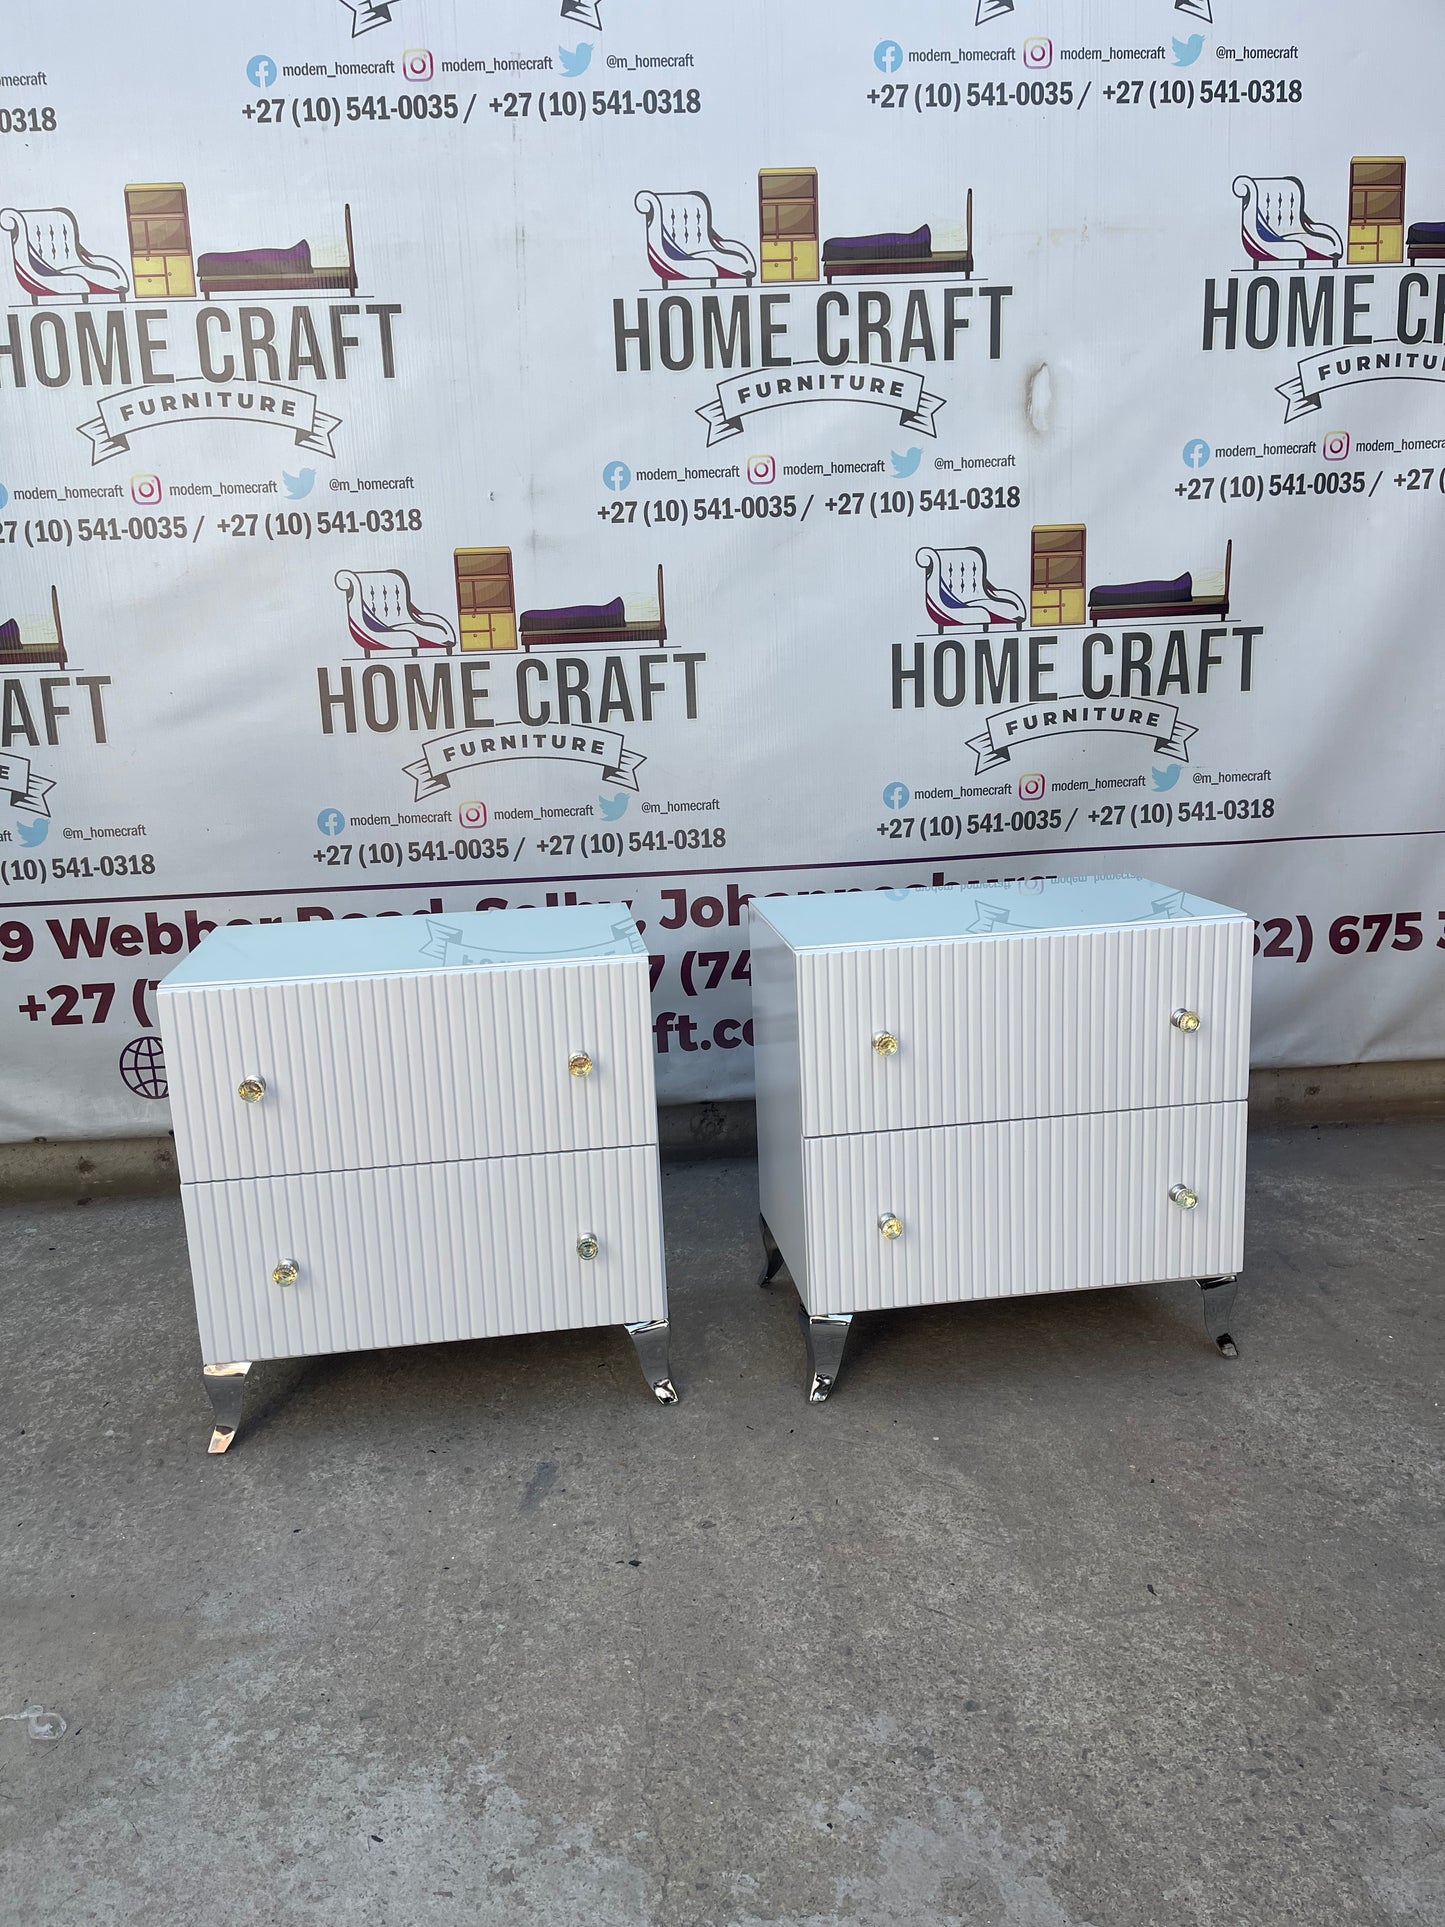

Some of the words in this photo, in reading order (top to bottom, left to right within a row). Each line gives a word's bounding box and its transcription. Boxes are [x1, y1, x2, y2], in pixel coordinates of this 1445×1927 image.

[607, 53, 694, 70] @m_homecraft
[1216, 46, 1298, 61] @m_homecraft
[0, 72, 47, 86] mecraft
[242, 99, 285, 123] +27
[292, 97, 340, 127] (10)
[347, 94, 458, 120] 541-0035
[490, 93, 531, 117] +27
[539, 91, 586, 122] (10)
[593, 89, 700, 115] 541-0318
[867, 84, 908, 108] +27
[915, 83, 960, 113] (10)
[967, 82, 1073, 106] 541-0035
[1103, 81, 1143, 103] +27
[1150, 80, 1194, 109] (10)
[1200, 80, 1302, 103] 541-0318
[0, 107, 56, 133] 0318
[613, 294, 791, 371] HOME
[817, 286, 1013, 366] CRAFT
[1203, 275, 1374, 350] HOME
[0, 309, 174, 388] HOME
[196, 304, 402, 383] CRAFT
[1318, 353, 1445, 380] FURNITU
[738, 375, 904, 404] FURNITURE
[120, 392, 295, 421] FURNITURE
[935, 455, 1015, 471] @m_homecraft
[330, 476, 414, 491] @m_homecraft
[1175, 478, 1214, 500] +27
[1220, 476, 1263, 503] (10)
[1269, 472, 1365, 496] 541-0035
[1394, 468, 1434, 490] +27
[598, 501, 637, 523] +27
[644, 500, 688, 527] (10)
[694, 495, 796, 520] 541-0035
[825, 493, 864, 515] +27
[871, 491, 914, 518] (10)
[920, 486, 1020, 511] 541-0318
[25, 520, 72, 547] (10)
[78, 516, 187, 541] 541-0035
[218, 514, 258, 536] +27
[266, 513, 311, 540] (10)
[318, 509, 422, 534] 541-0318
[892, 636, 1057, 709] HOME
[1083, 626, 1263, 699] CRAFT
[317, 661, 494, 734] HOME
[516, 653, 706, 726] CRAFT
[2, 676, 111, 747] AFT
[1006, 707, 1159, 736] FURNITURE
[443, 735, 604, 762] FURNITURE
[1193, 770, 1271, 785] @m_homecraft
[642, 799, 720, 814] @m_homecraft
[877, 818, 914, 838] +27
[921, 816, 961, 841] (10)
[967, 809, 1061, 834] 541-0035
[1088, 805, 1125, 825] +27
[1131, 803, 1172, 828] (10)
[1178, 798, 1274, 822] 541-0318
[63, 824, 146, 840] @m_homecraft
[314, 845, 352, 865] +27
[359, 843, 402, 868] (10)
[409, 838, 509, 862] 541-0035
[537, 835, 574, 855] +27
[581, 833, 623, 858] (10)
[629, 828, 726, 851] 541-0318
[1, 859, 46, 885] (10)
[52, 854, 155, 878] 541-0318
[46, 910, 282, 960] Webb
[1254, 915, 1313, 963] 2)
[1329, 911, 1423, 955] 675
[19, 983, 116, 1026] +27
